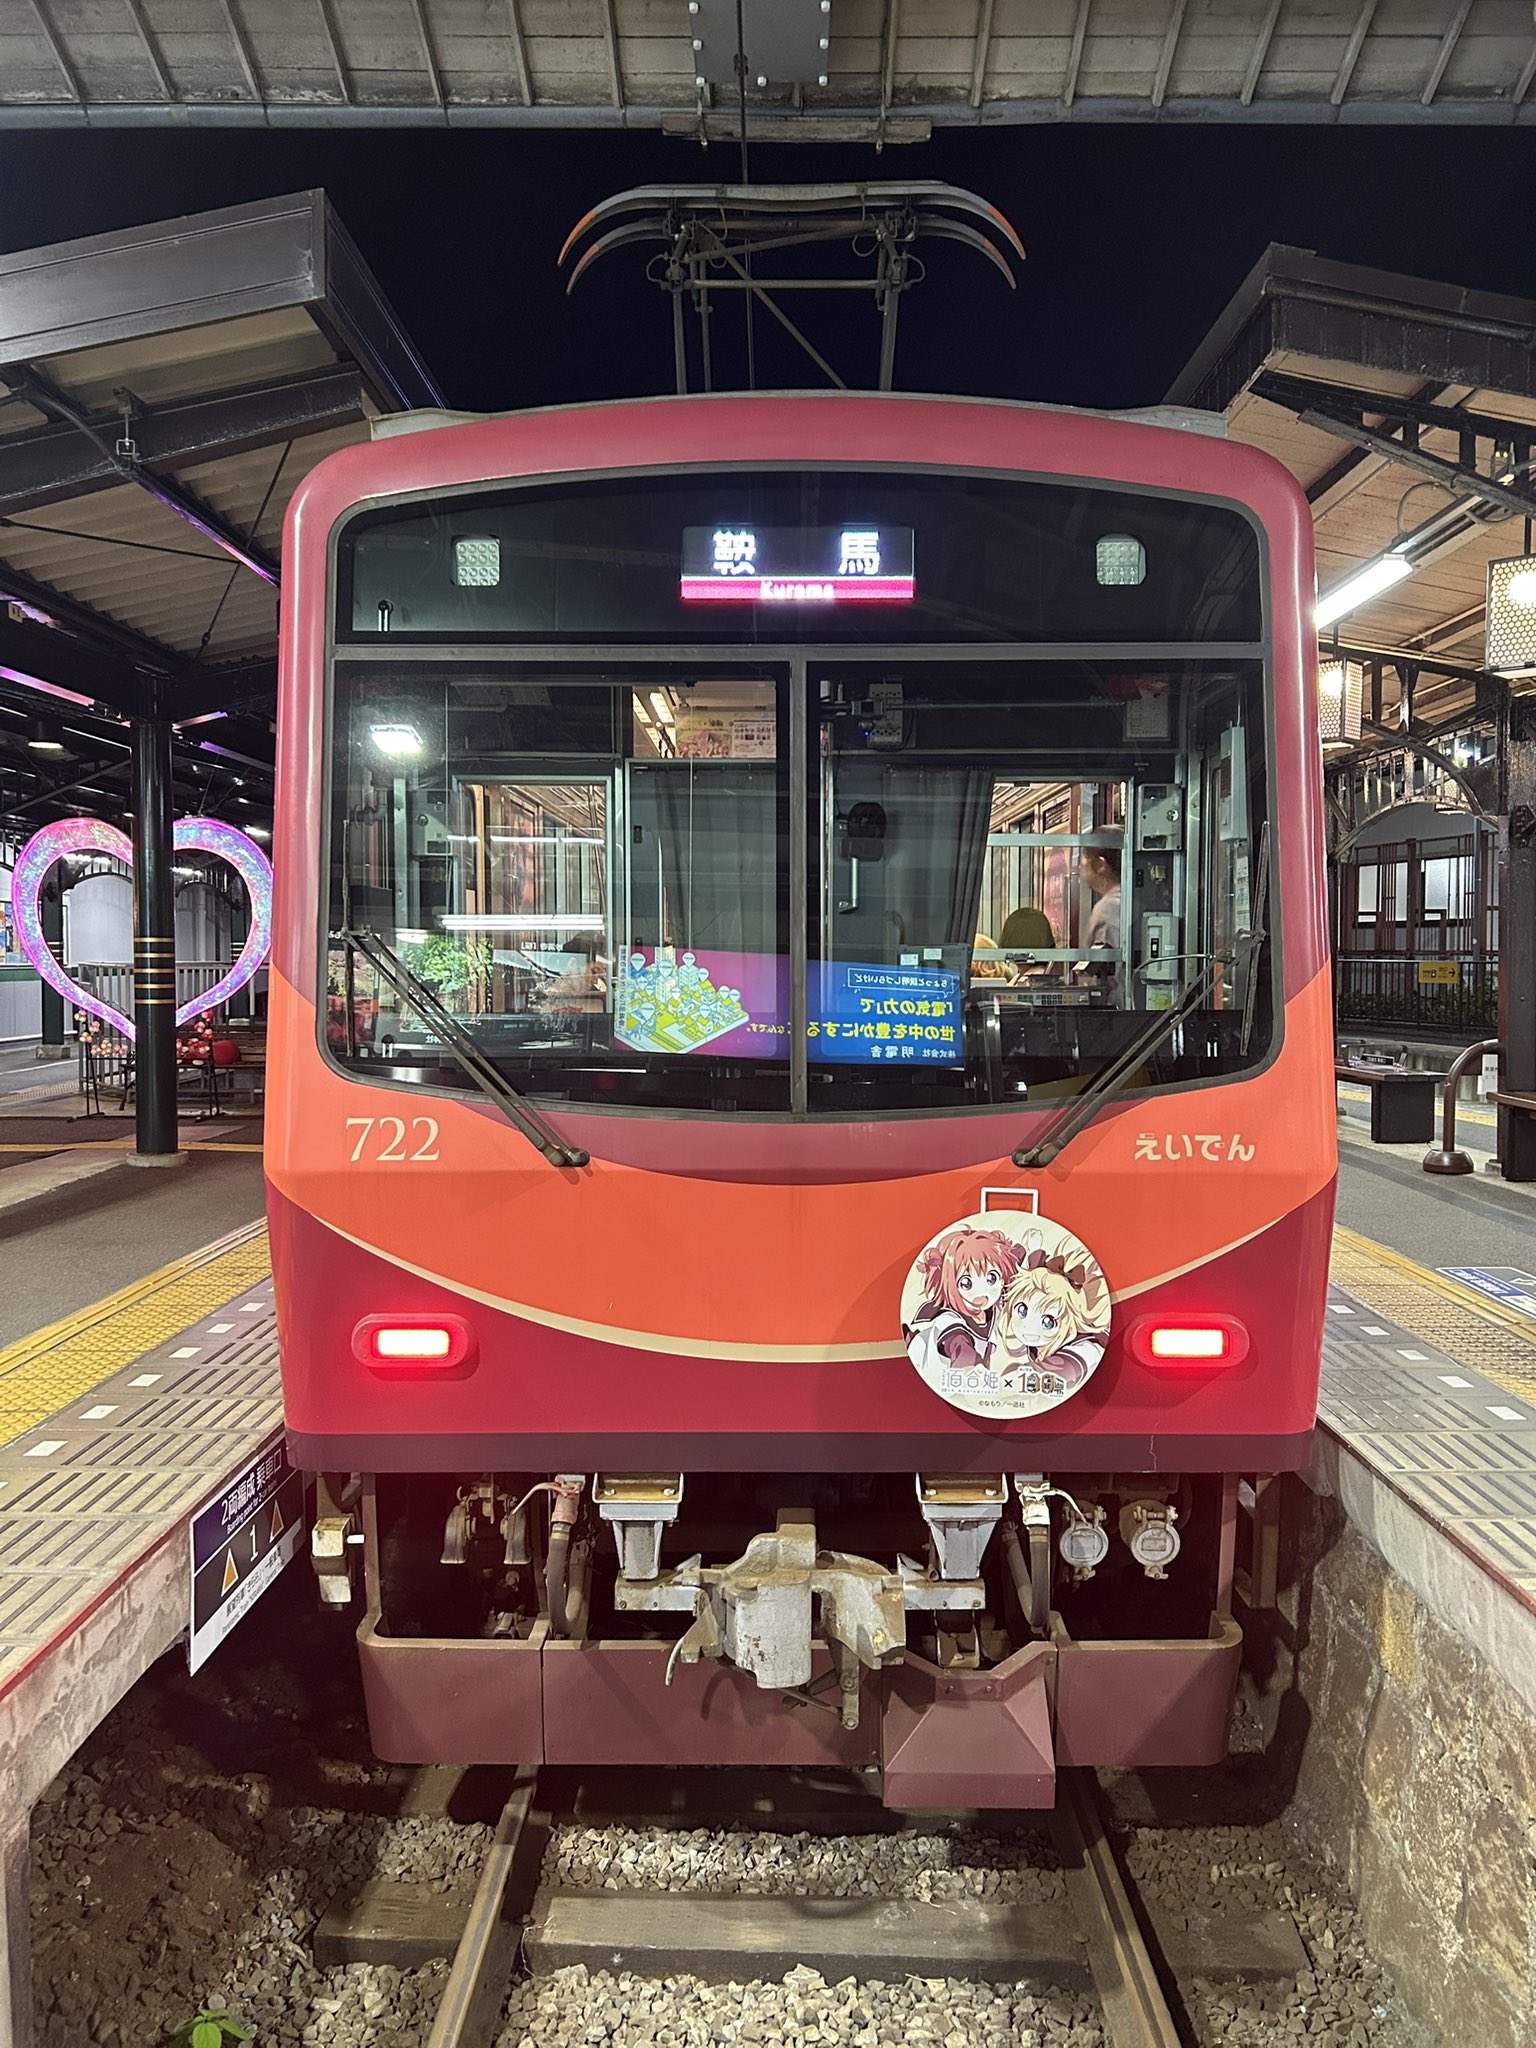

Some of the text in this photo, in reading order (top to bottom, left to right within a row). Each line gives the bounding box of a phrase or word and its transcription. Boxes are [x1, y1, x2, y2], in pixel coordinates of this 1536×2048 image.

[759, 581, 835, 600] Kurama
[345, 1116, 440, 1162] 722
[1134, 1133, 1256, 1162] えいでん
[949, 1369, 999, 1389] 百合姫
[221, 1447, 282, 1526] 2両編成 乗車口
[249, 1523, 259, 1562] 1
